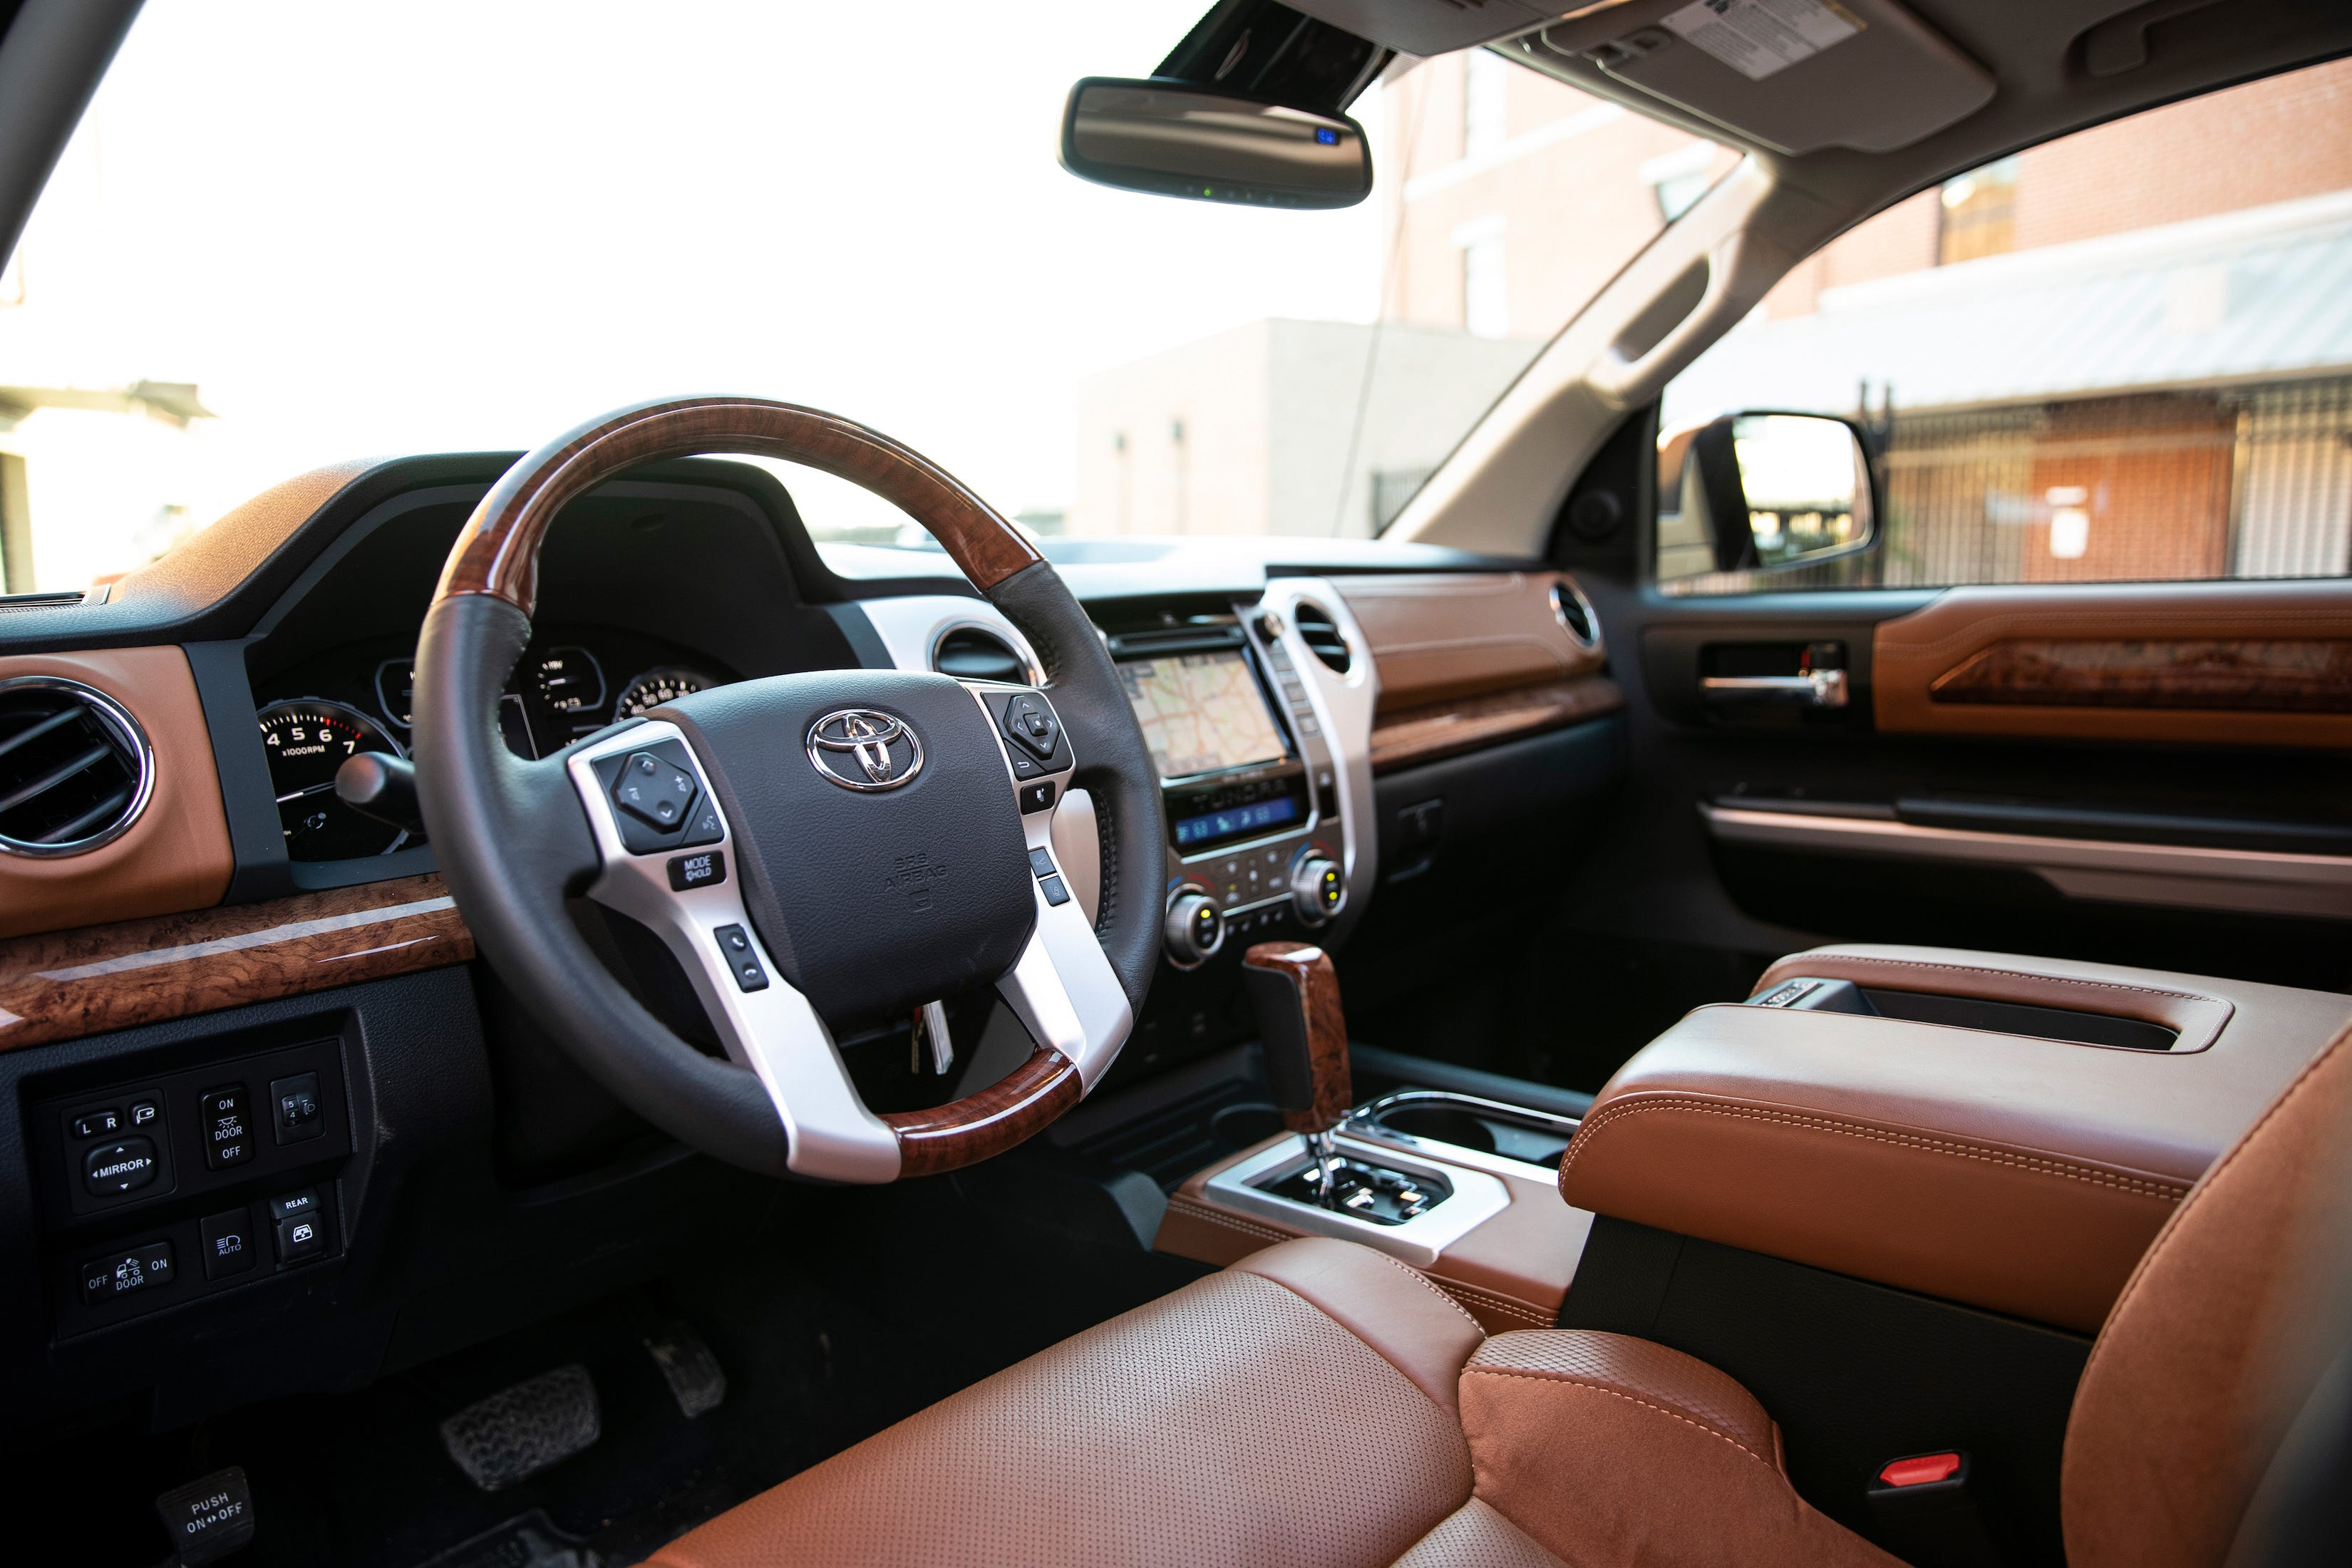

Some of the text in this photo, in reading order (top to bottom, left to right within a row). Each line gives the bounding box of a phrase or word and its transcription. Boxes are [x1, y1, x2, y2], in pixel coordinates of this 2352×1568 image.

[267, 727, 355, 754] 4 5 6 7
[684, 855, 711, 871] MODE
[692, 867, 712, 879] HOLD
[218, 1098, 234, 1110] ON
[83, 1118, 117, 1135] L R
[215, 1126, 243, 1140] DOOR
[222, 1146, 241, 1159] OFF
[99, 1159, 144, 1177] MIRROR
[285, 1197, 309, 1209] REAR
[218, 1244, 242, 1256] AUTO
[88, 1258, 168, 1291] OFF DOOR ON
[191, 1492, 229, 1515] PUSH
[187, 1501, 242, 1533] ON OFF
